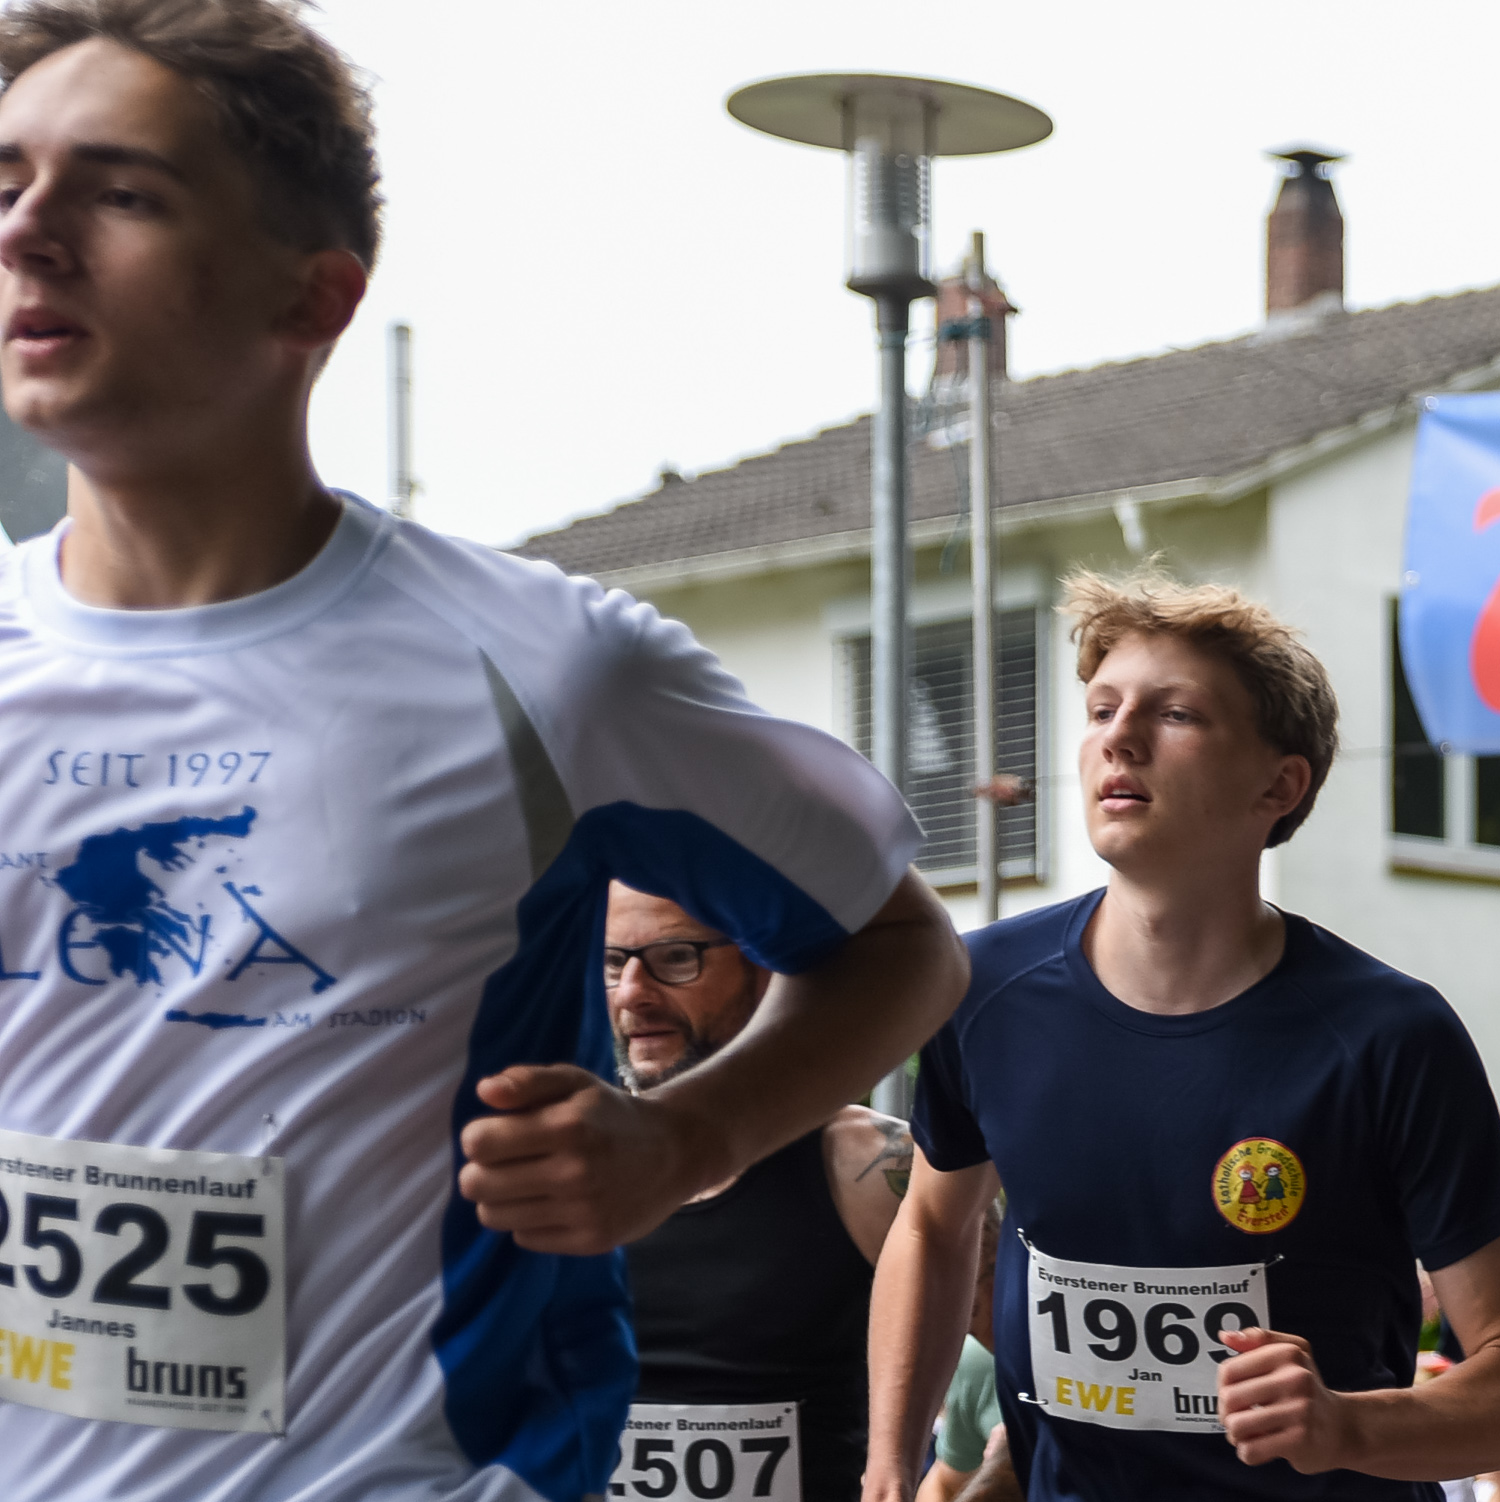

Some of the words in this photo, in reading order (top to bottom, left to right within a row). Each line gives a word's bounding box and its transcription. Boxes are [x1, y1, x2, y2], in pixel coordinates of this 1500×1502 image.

[44, 749, 145, 787] SEIT
[168, 751, 272, 787] 1997
[0, 1157, 76, 1182] rstener
[85, 1165, 257, 1199] Brunnenlauf
[0, 1187, 270, 1316] 525
[1038, 1266, 1128, 1293] Everstener
[1133, 1279, 1250, 1296] Brunnenlauf
[47, 1309, 137, 1339] Jannes
[1037, 1291, 1260, 1366] 1969
[0, 1328, 76, 1390] WE
[127, 1347, 248, 1399] bruns
[1128, 1368, 1163, 1382] Jan
[1056, 1376, 1136, 1416] EWE
[1173, 1386, 1219, 1415] bru
[626, 1418, 672, 1430] tener
[677, 1416, 783, 1431] Brunnenlauf
[609, 1436, 790, 1500] 507
